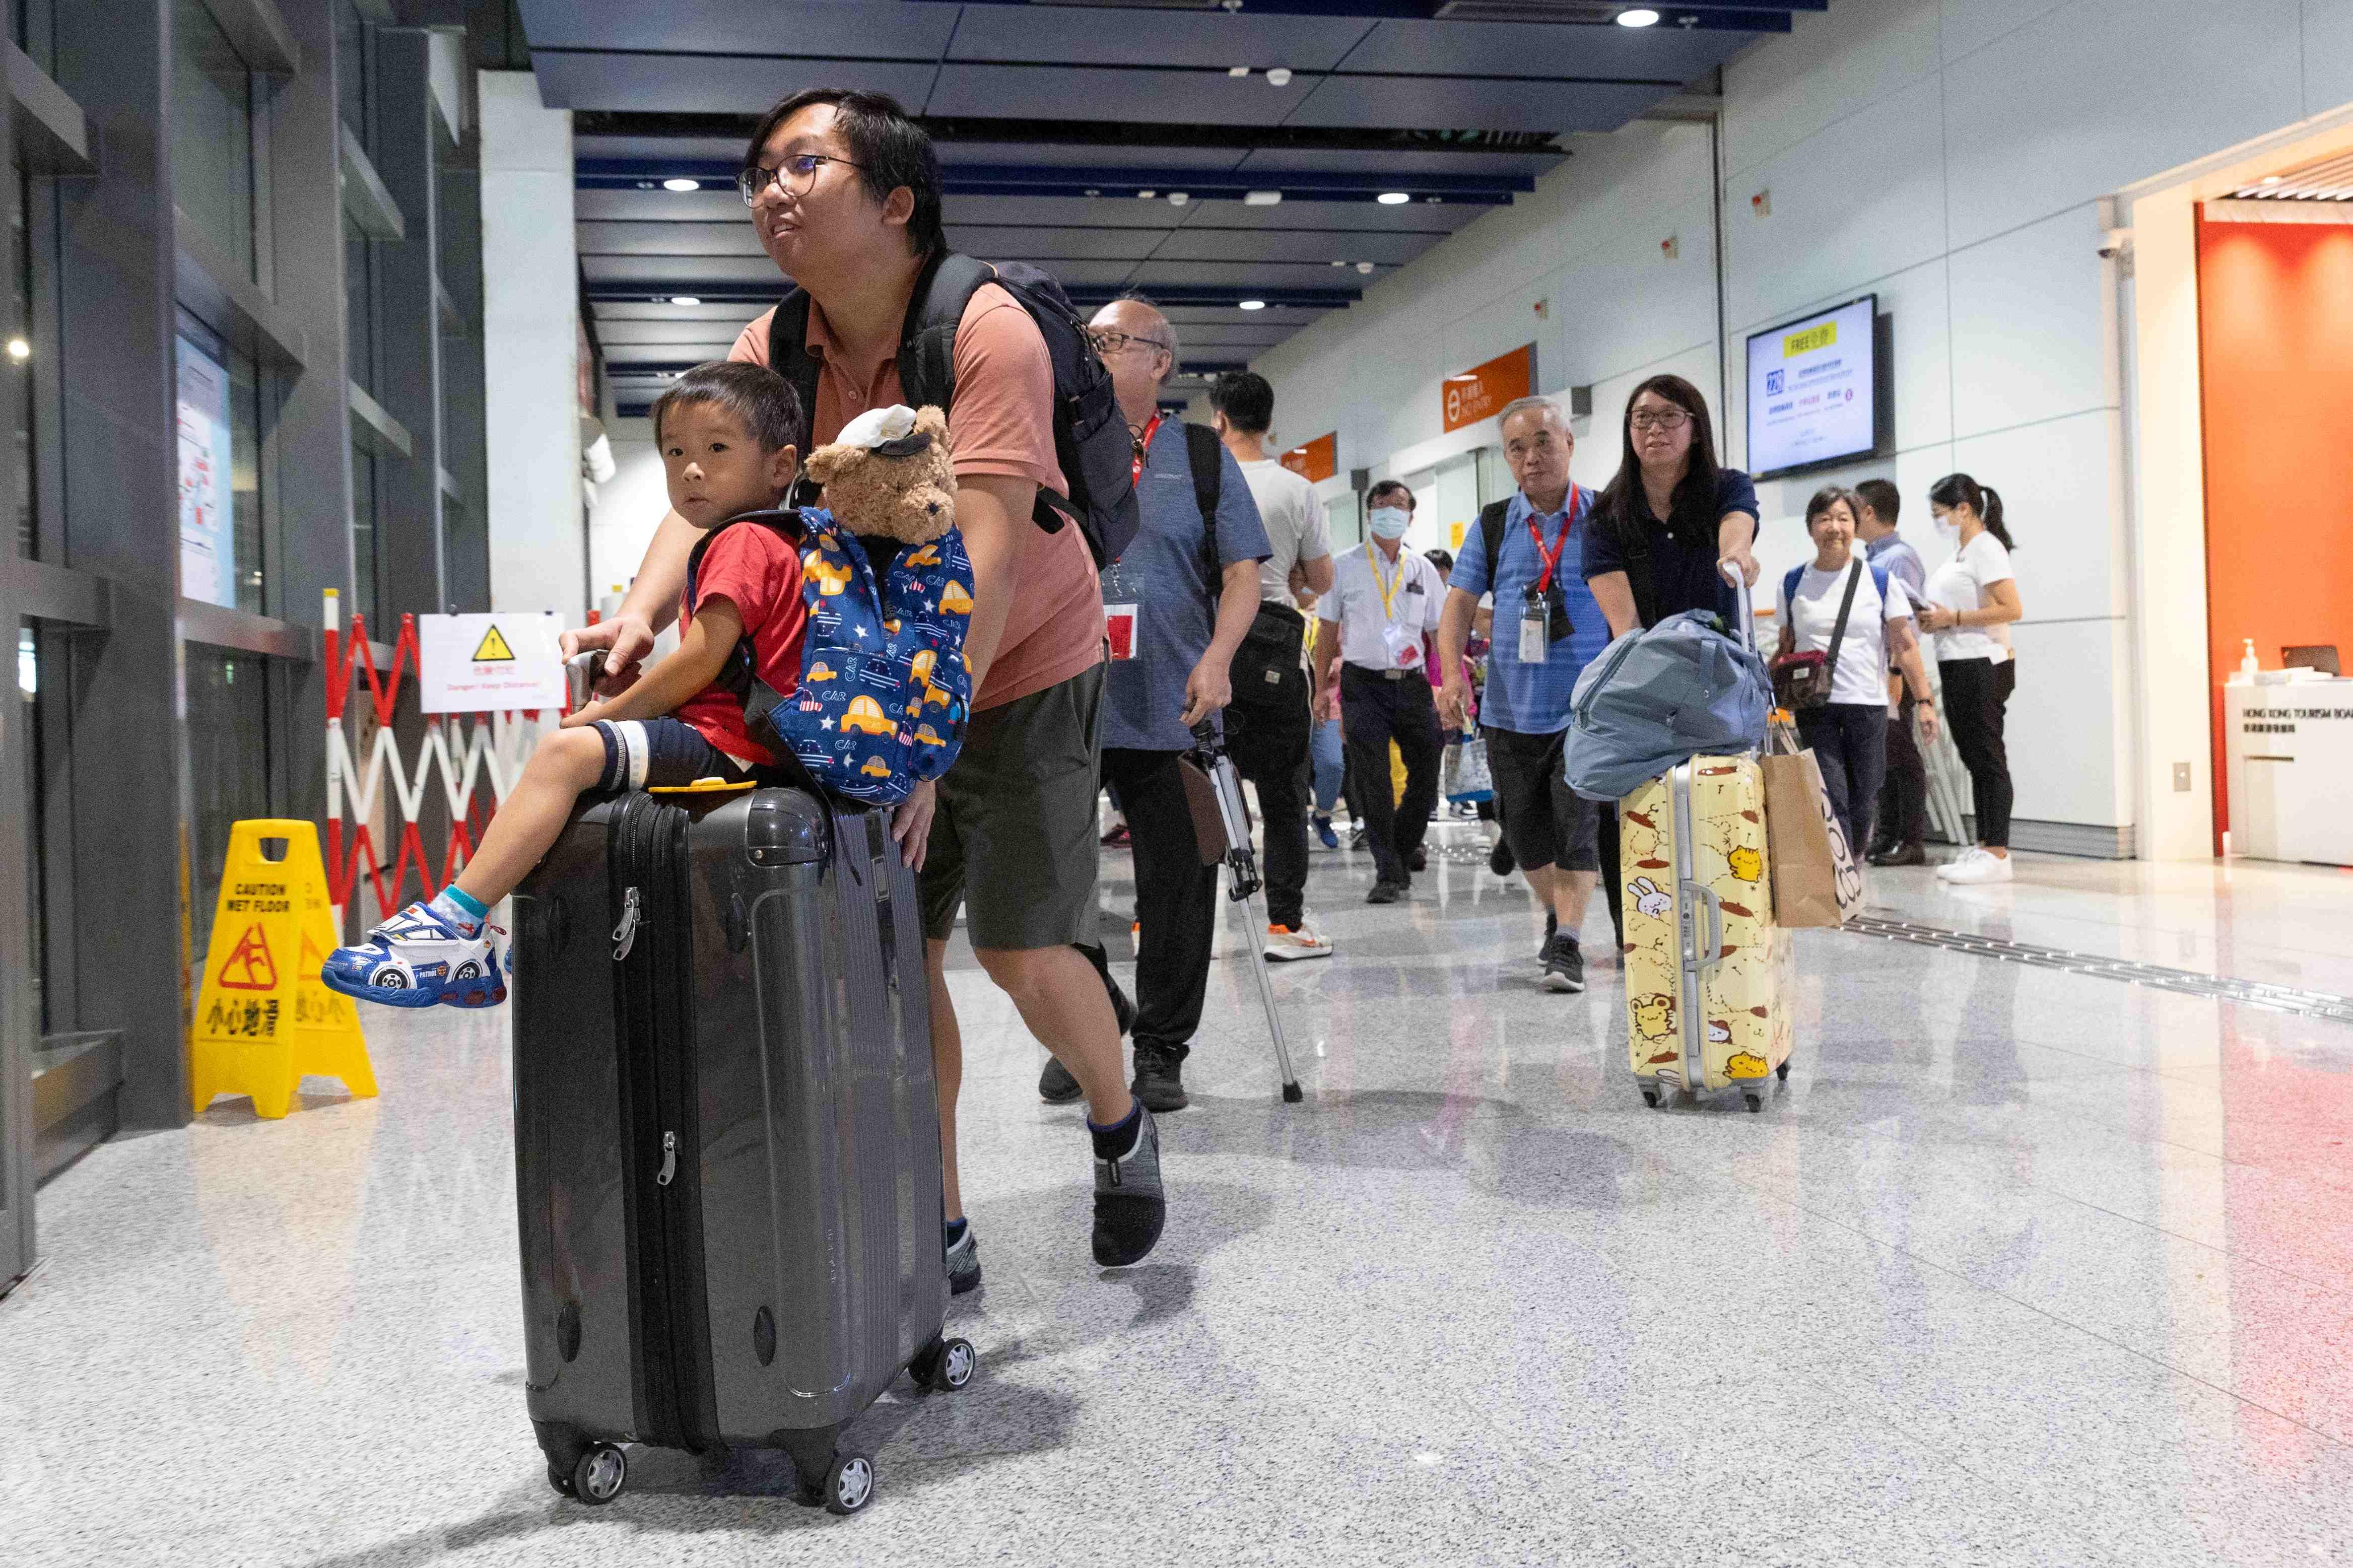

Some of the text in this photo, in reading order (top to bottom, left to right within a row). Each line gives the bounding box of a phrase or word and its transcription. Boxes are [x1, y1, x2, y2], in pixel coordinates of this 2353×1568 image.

[845, 657, 857, 681] CAR
[822, 691, 846, 702] CAR
[2243, 708, 2266, 718] HONG
[2268, 708, 2291, 719] KONG
[835, 739, 857, 750] CAR
[235, 883, 286, 895] CAUTION
[228, 900, 290, 912] WET FLOOR
[419, 970, 437, 978] PATROL
